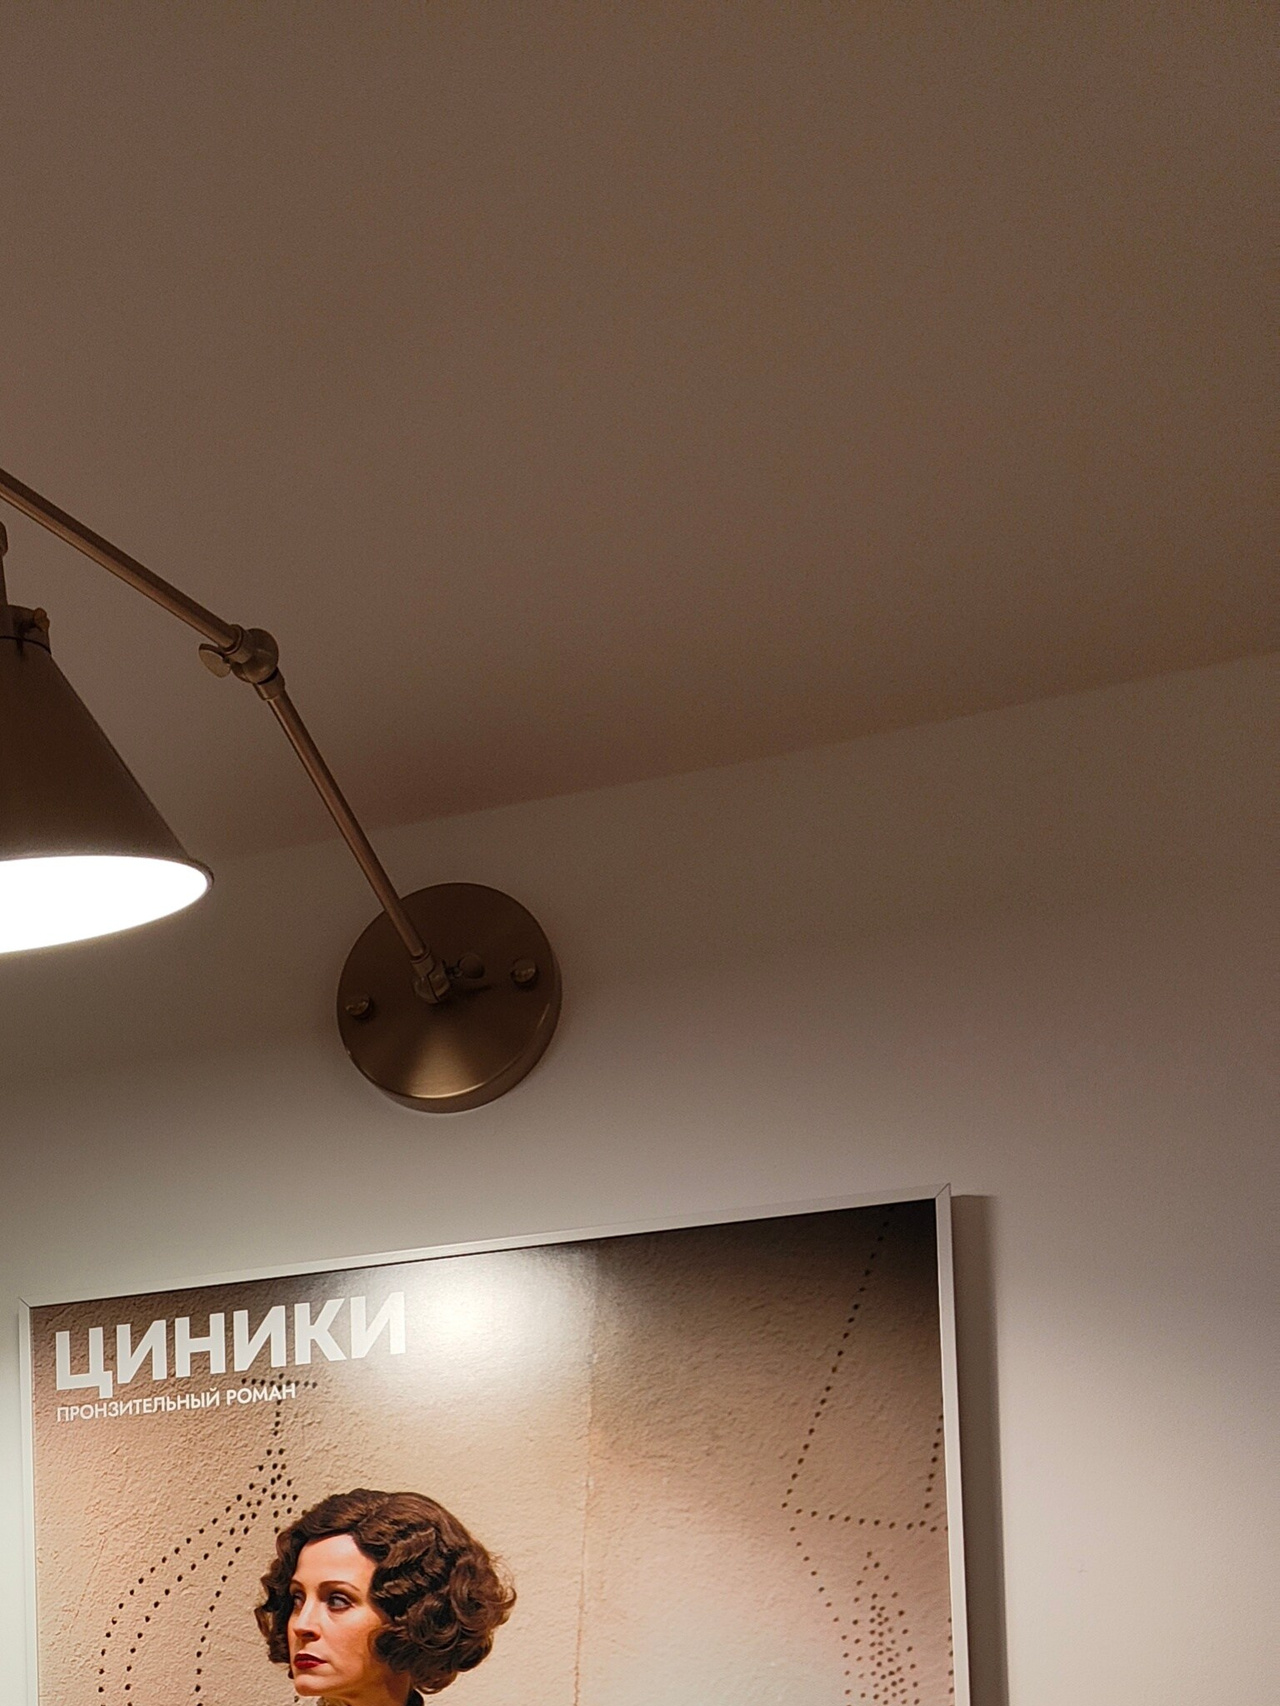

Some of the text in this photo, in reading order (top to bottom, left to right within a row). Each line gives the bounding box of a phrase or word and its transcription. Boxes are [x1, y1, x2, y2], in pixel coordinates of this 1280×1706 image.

[54, 1291, 406, 1399] ЦИНИКИ
[57, 1383, 296, 1423] ПРОНЗИТЕЛЬНЫЙ РОМАН
